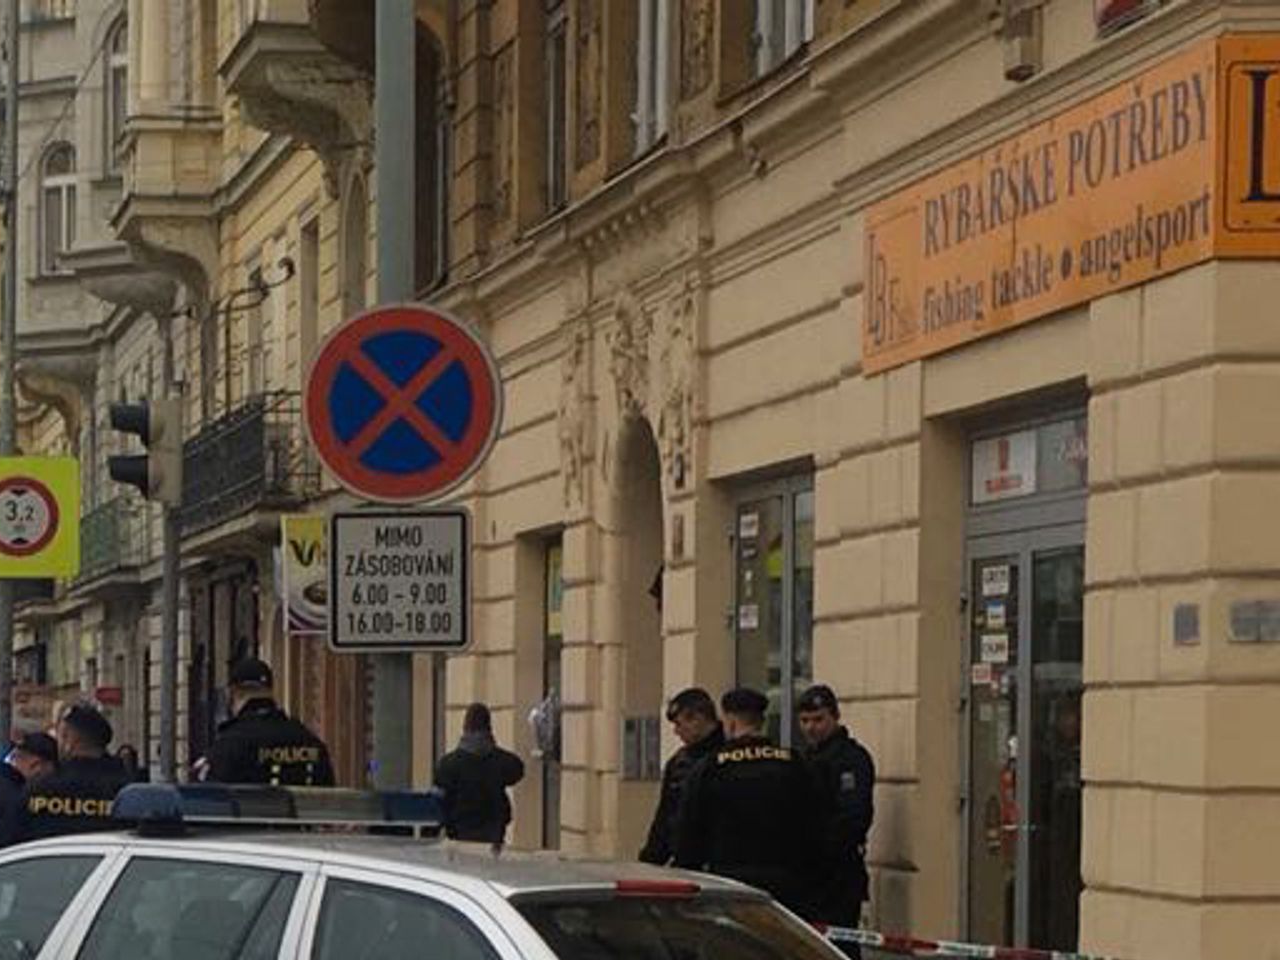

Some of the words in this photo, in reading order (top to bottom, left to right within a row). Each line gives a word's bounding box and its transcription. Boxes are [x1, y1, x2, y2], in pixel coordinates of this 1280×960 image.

[924, 120, 1058, 258] RYBÁŘSKÉ
[1067, 70, 1210, 197] POTŘEBY
[923, 277, 985, 335] fishing
[991, 244, 1052, 310] tackle
[1080, 186, 1210, 282] angelsport
[375, 526, 423, 548] MIMO
[345, 549, 454, 577] ZÁSOBOVÁNÍ
[352, 583, 388, 605] 6.00
[410, 583, 446, 605] 9.00
[348, 612, 452, 634] 16.00-18.00
